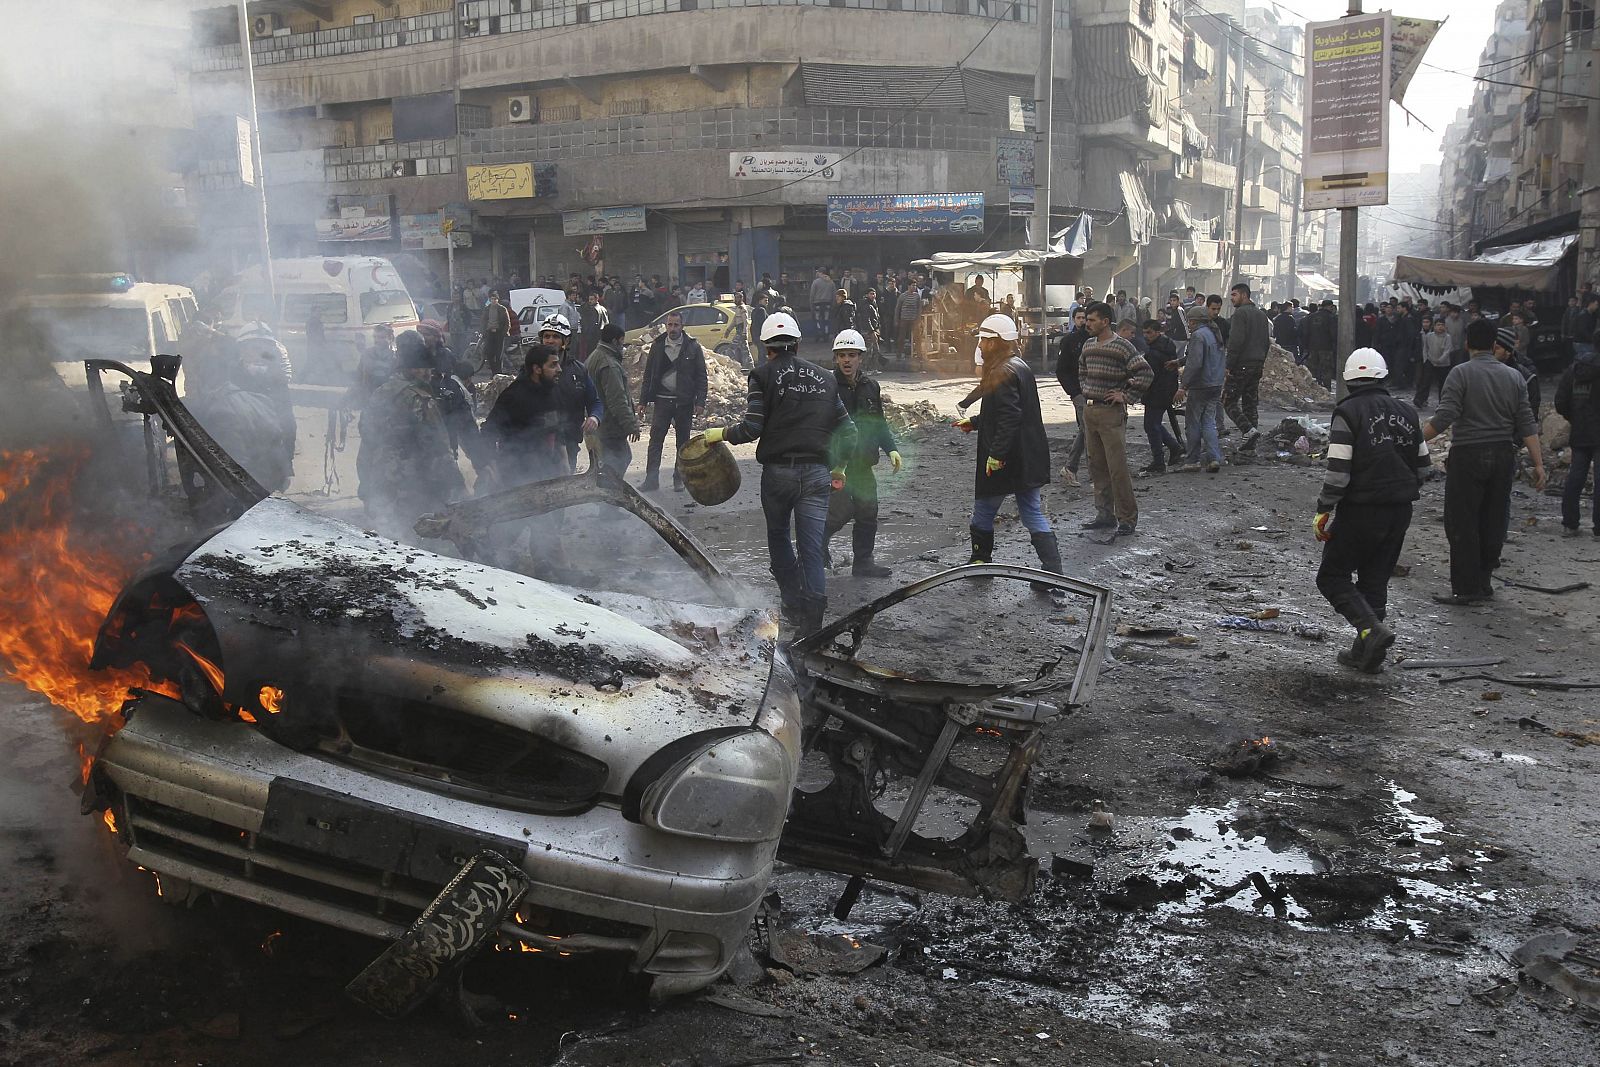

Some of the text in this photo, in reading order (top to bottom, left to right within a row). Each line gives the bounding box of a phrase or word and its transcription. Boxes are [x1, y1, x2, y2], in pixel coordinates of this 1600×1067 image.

[1349, 27, 1380, 40] هجمات
[798, 367, 826, 385] الدفاع
[807, 384, 826, 394] مركز
[1388, 414, 1415, 435] الدفاع
[1396, 435, 1413, 447] مركز
